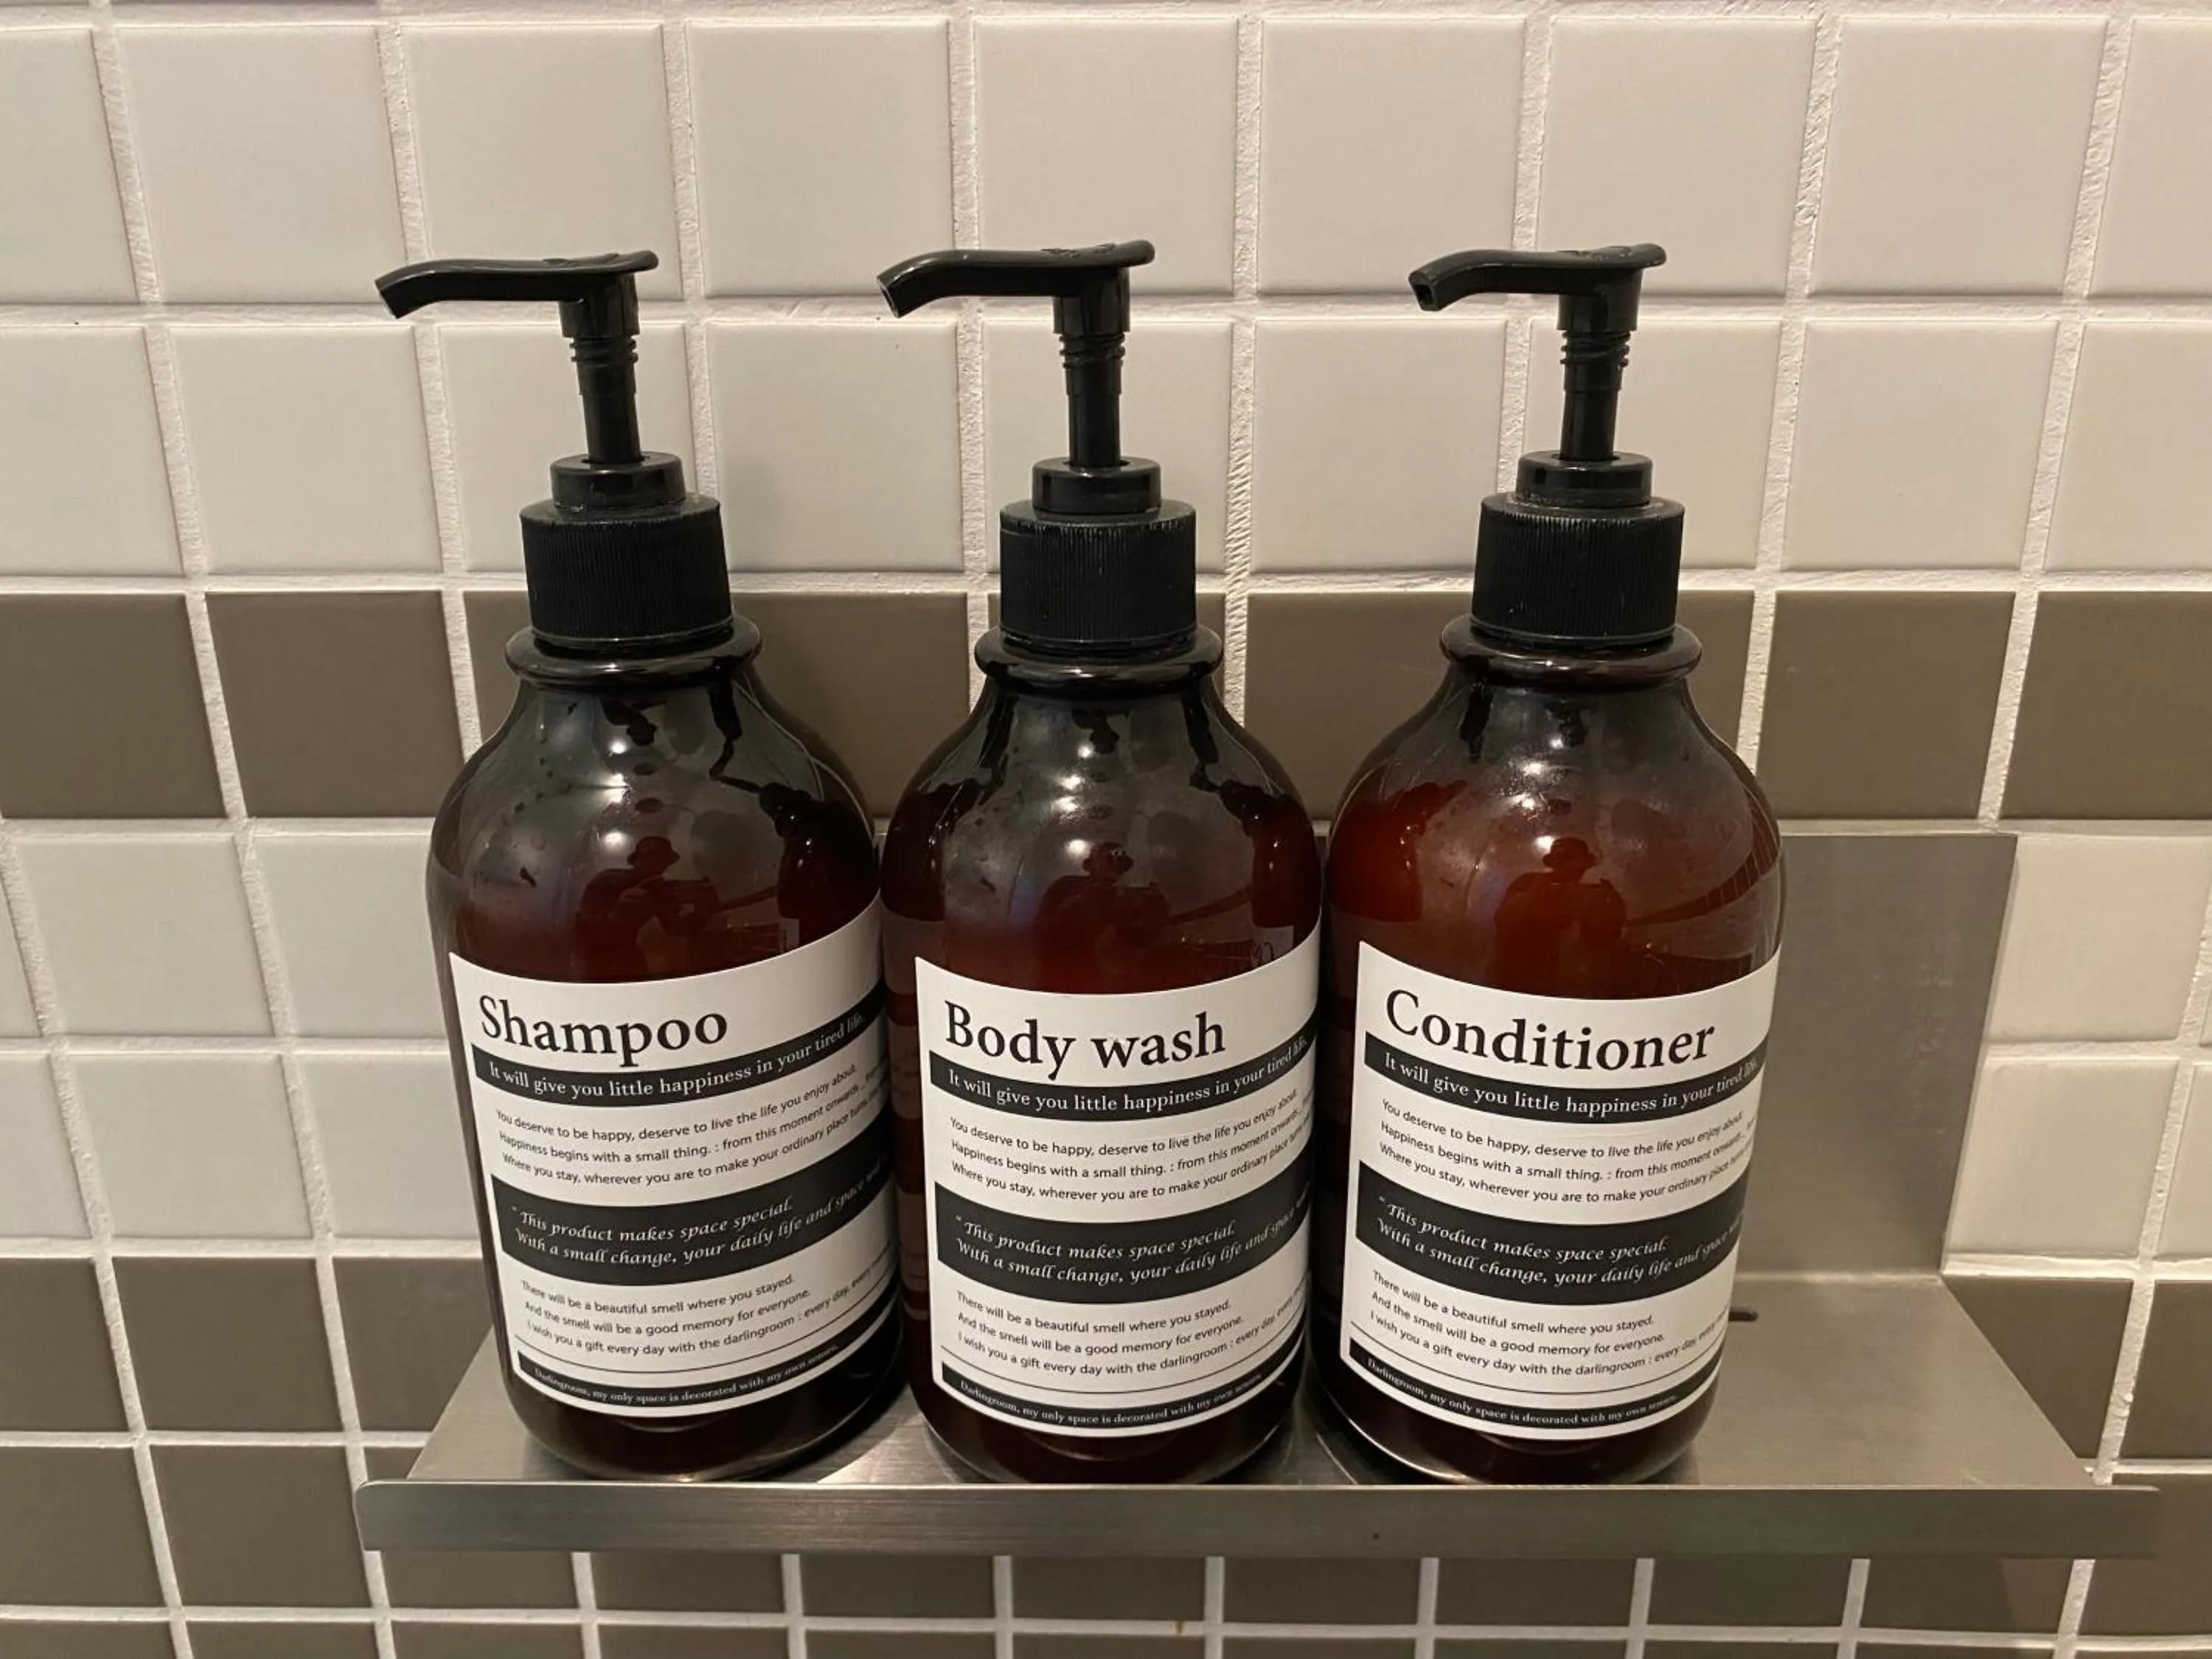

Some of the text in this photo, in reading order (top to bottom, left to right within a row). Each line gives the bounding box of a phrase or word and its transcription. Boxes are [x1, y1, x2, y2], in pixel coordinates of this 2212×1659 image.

[479, 995, 728, 1067] Shampoo
[489, 1060, 500, 1079] It
[501, 1071, 529, 1088] will
[533, 1076, 566, 1095] give
[570, 1084, 603, 1099] you
[608, 1079, 653, 1096] little
[659, 1066, 751, 1095] happiness
[756, 1059, 773, 1074] in
[776, 1045, 812, 1073] your
[814, 1023, 844, 1051] tired
[944, 1001, 1225, 1079] Body wash
[1386, 990, 1715, 1071] Conditioner
[948, 1046, 1291, 1113] It will give you little happiness in your tired
[1385, 1051, 1742, 1118] It will give you little happiness in your tired
[495, 1109, 512, 1124] You
[513, 1116, 554, 1135] deserve
[556, 1126, 570, 1138] to
[572, 1127, 589, 1139] be
[637, 1127, 689, 1140] deserve
[692, 1123, 708, 1133] to
[711, 1118, 734, 1130] live
[736, 1111, 757, 1124] the
[759, 1103, 778, 1117] life
[780, 1096, 801, 1113] you
[803, 1082, 830, 1101] enjoy
[1382, 1098, 1400, 1117] You
[1402, 1110, 1447, 1135] deserve
[1450, 1127, 1464, 1139] to
[1466, 1130, 1483, 1145] be
[1534, 1144, 1587, 1157] deserve
[1590, 1147, 1604, 1158] to
[1607, 1146, 1630, 1157] live
[1632, 1143, 1654, 1155] the
[1656, 1138, 1673, 1152] life
[1675, 1135, 1695, 1151] you
[950, 1139, 1004, 1167] Happiness
[1006, 1156, 1046, 1175] begins
[1048, 1165, 1077, 1178] with
[1081, 1168, 1089, 1178] a
[1092, 1165, 1126, 1178] small
[1177, 1156, 1206, 1170] from
[1207, 1149, 1228, 1163] this
[1230, 1130, 1269, 1155] moment
[951, 1160, 983, 1182] Where
[985, 1176, 1006, 1189] you
[1038, 1186, 1098, 1200] wherever
[1100, 1191, 1124, 1203] you
[1128, 1189, 1148, 1199] are
[1152, 1186, 1165, 1197] to
[1168, 1179, 1200, 1194] make
[1202, 1171, 1228, 1189] your
[519, 1211, 546, 1231] This
[548, 1223, 612, 1241] product
[619, 1225, 674, 1241] makes
[679, 1220, 728, 1242] space
[1386, 1203, 1416, 1226] This
[1419, 1221, 1486, 1249] product
[1492, 1242, 1551, 1259] makes
[1555, 1249, 1604, 1265] space
[956, 1237, 989, 1263] With
[992, 1258, 1003, 1268] a
[1008, 1262, 1056, 1279] small
[1130, 1265, 1171, 1283] your
[1174, 1251, 1216, 1273] daily
[1220, 1244, 1242, 1261] life
[562, 1316, 591, 1329] smell
[592, 1322, 613, 1332] will
[615, 1323, 632, 1334] be
[634, 1326, 642, 1335] a
[644, 1321, 679, 1337] good
[681, 1315, 734, 1332] memory
[737, 1310, 754, 1321] for
[566, 1296, 582, 1309] be
[584, 1301, 591, 1310] a
[593, 1301, 647, 1314] beautiful
[650, 1301, 684, 1314] smell
[686, 1296, 726, 1310] where
[728, 1290, 753, 1306] you
[1371, 1290, 1391, 1310] And
[1392, 1304, 1411, 1320] the
[1413, 1314, 1443, 1332] smell
[1445, 1326, 1467, 1340] will
[1469, 1332, 1486, 1346] be
[1488, 1339, 1497, 1347] a
[1500, 1340, 1534, 1353] good
[1537, 1345, 1590, 1357] memory
[1593, 1343, 1610, 1354] for
[1373, 1269, 1399, 1294] There
[1401, 1288, 1421, 1303] will
[1423, 1295, 1439, 1310] be
[1441, 1305, 1448, 1314] a
[1451, 1305, 1507, 1329] beautiful
[1510, 1321, 1544, 1332] smell
[1547, 1323, 1587, 1334] where
[1590, 1324, 1613, 1336] you
[963, 1336, 986, 1352] wish
[987, 1346, 1008, 1360] you
[1009, 1355, 1018, 1363] a
[1019, 1357, 1040, 1369] gift
[1043, 1361, 1077, 1375] every
[1079, 1363, 1102, 1377] day
[1105, 1363, 1133, 1374] with
[1135, 1361, 1157, 1372] the
[1159, 1342, 1228, 1369] darlingroom
